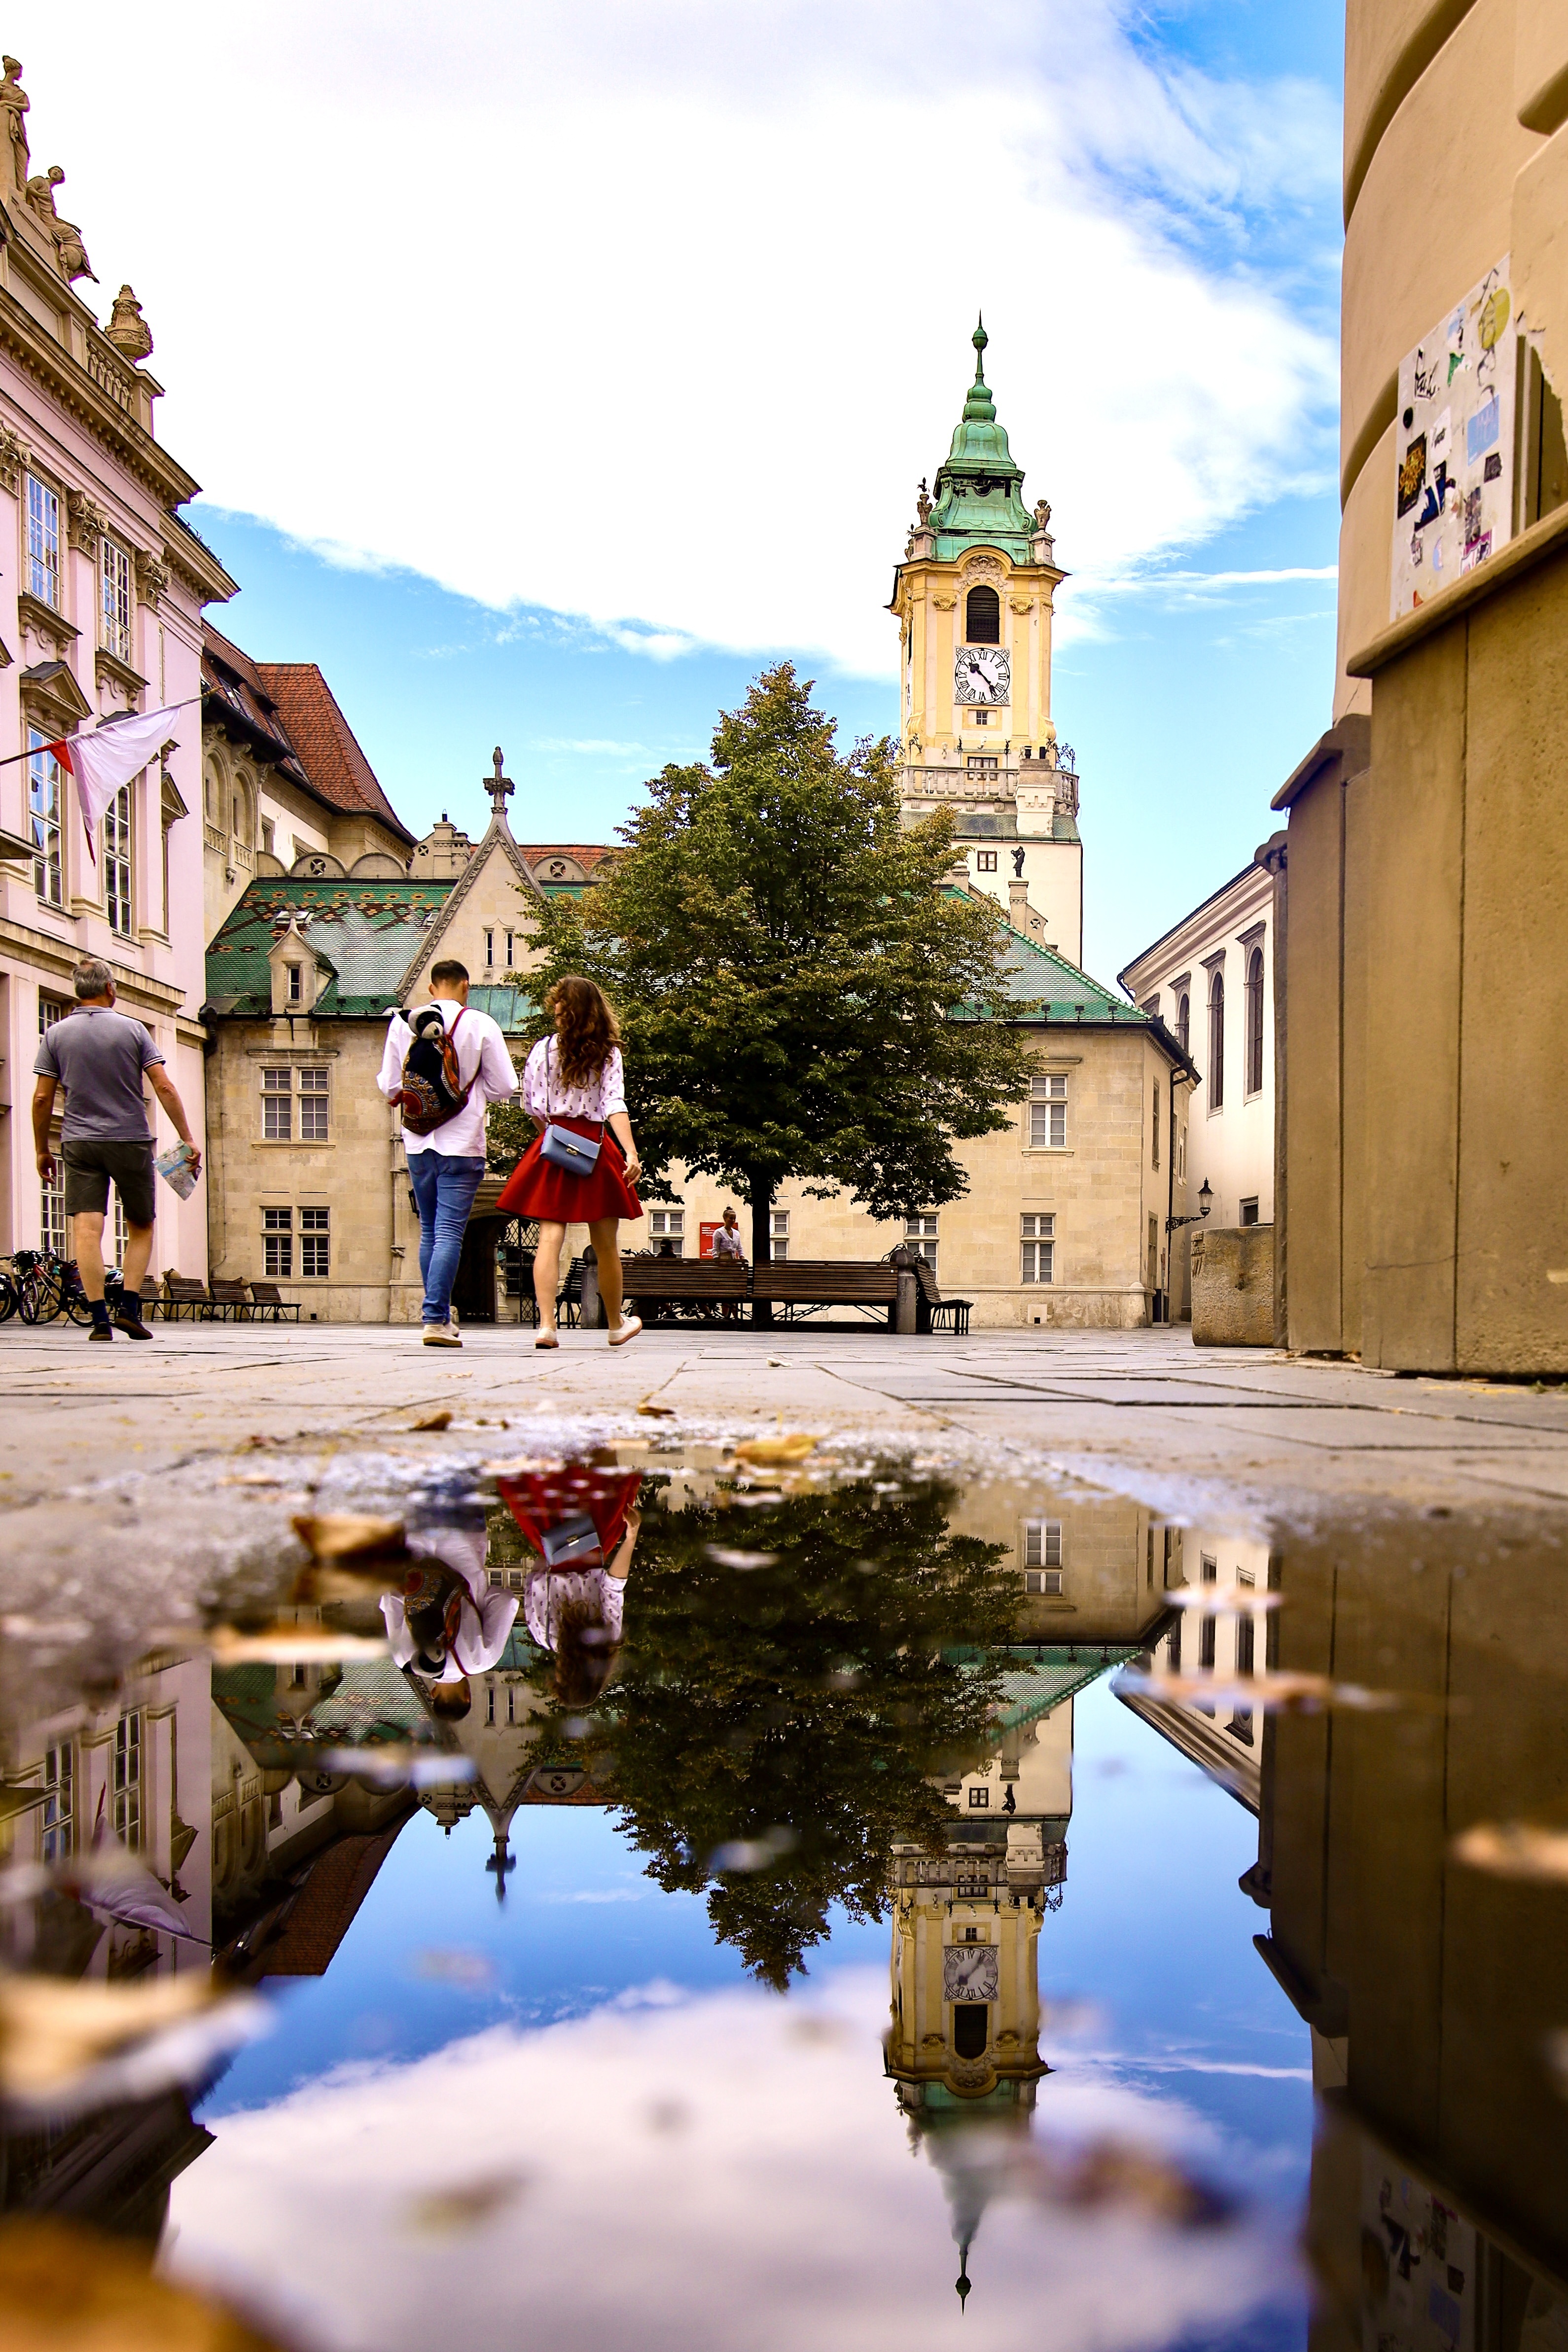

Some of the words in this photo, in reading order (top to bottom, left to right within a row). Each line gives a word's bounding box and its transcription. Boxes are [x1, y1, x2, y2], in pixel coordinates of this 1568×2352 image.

[967, 653, 976, 663] XI
[978, 652, 988, 660] XII
[960, 680, 970, 692] VIII
[995, 682, 1004, 692] IIII
[967, 688, 976, 698] VII
[979, 692, 986, 700] VI
